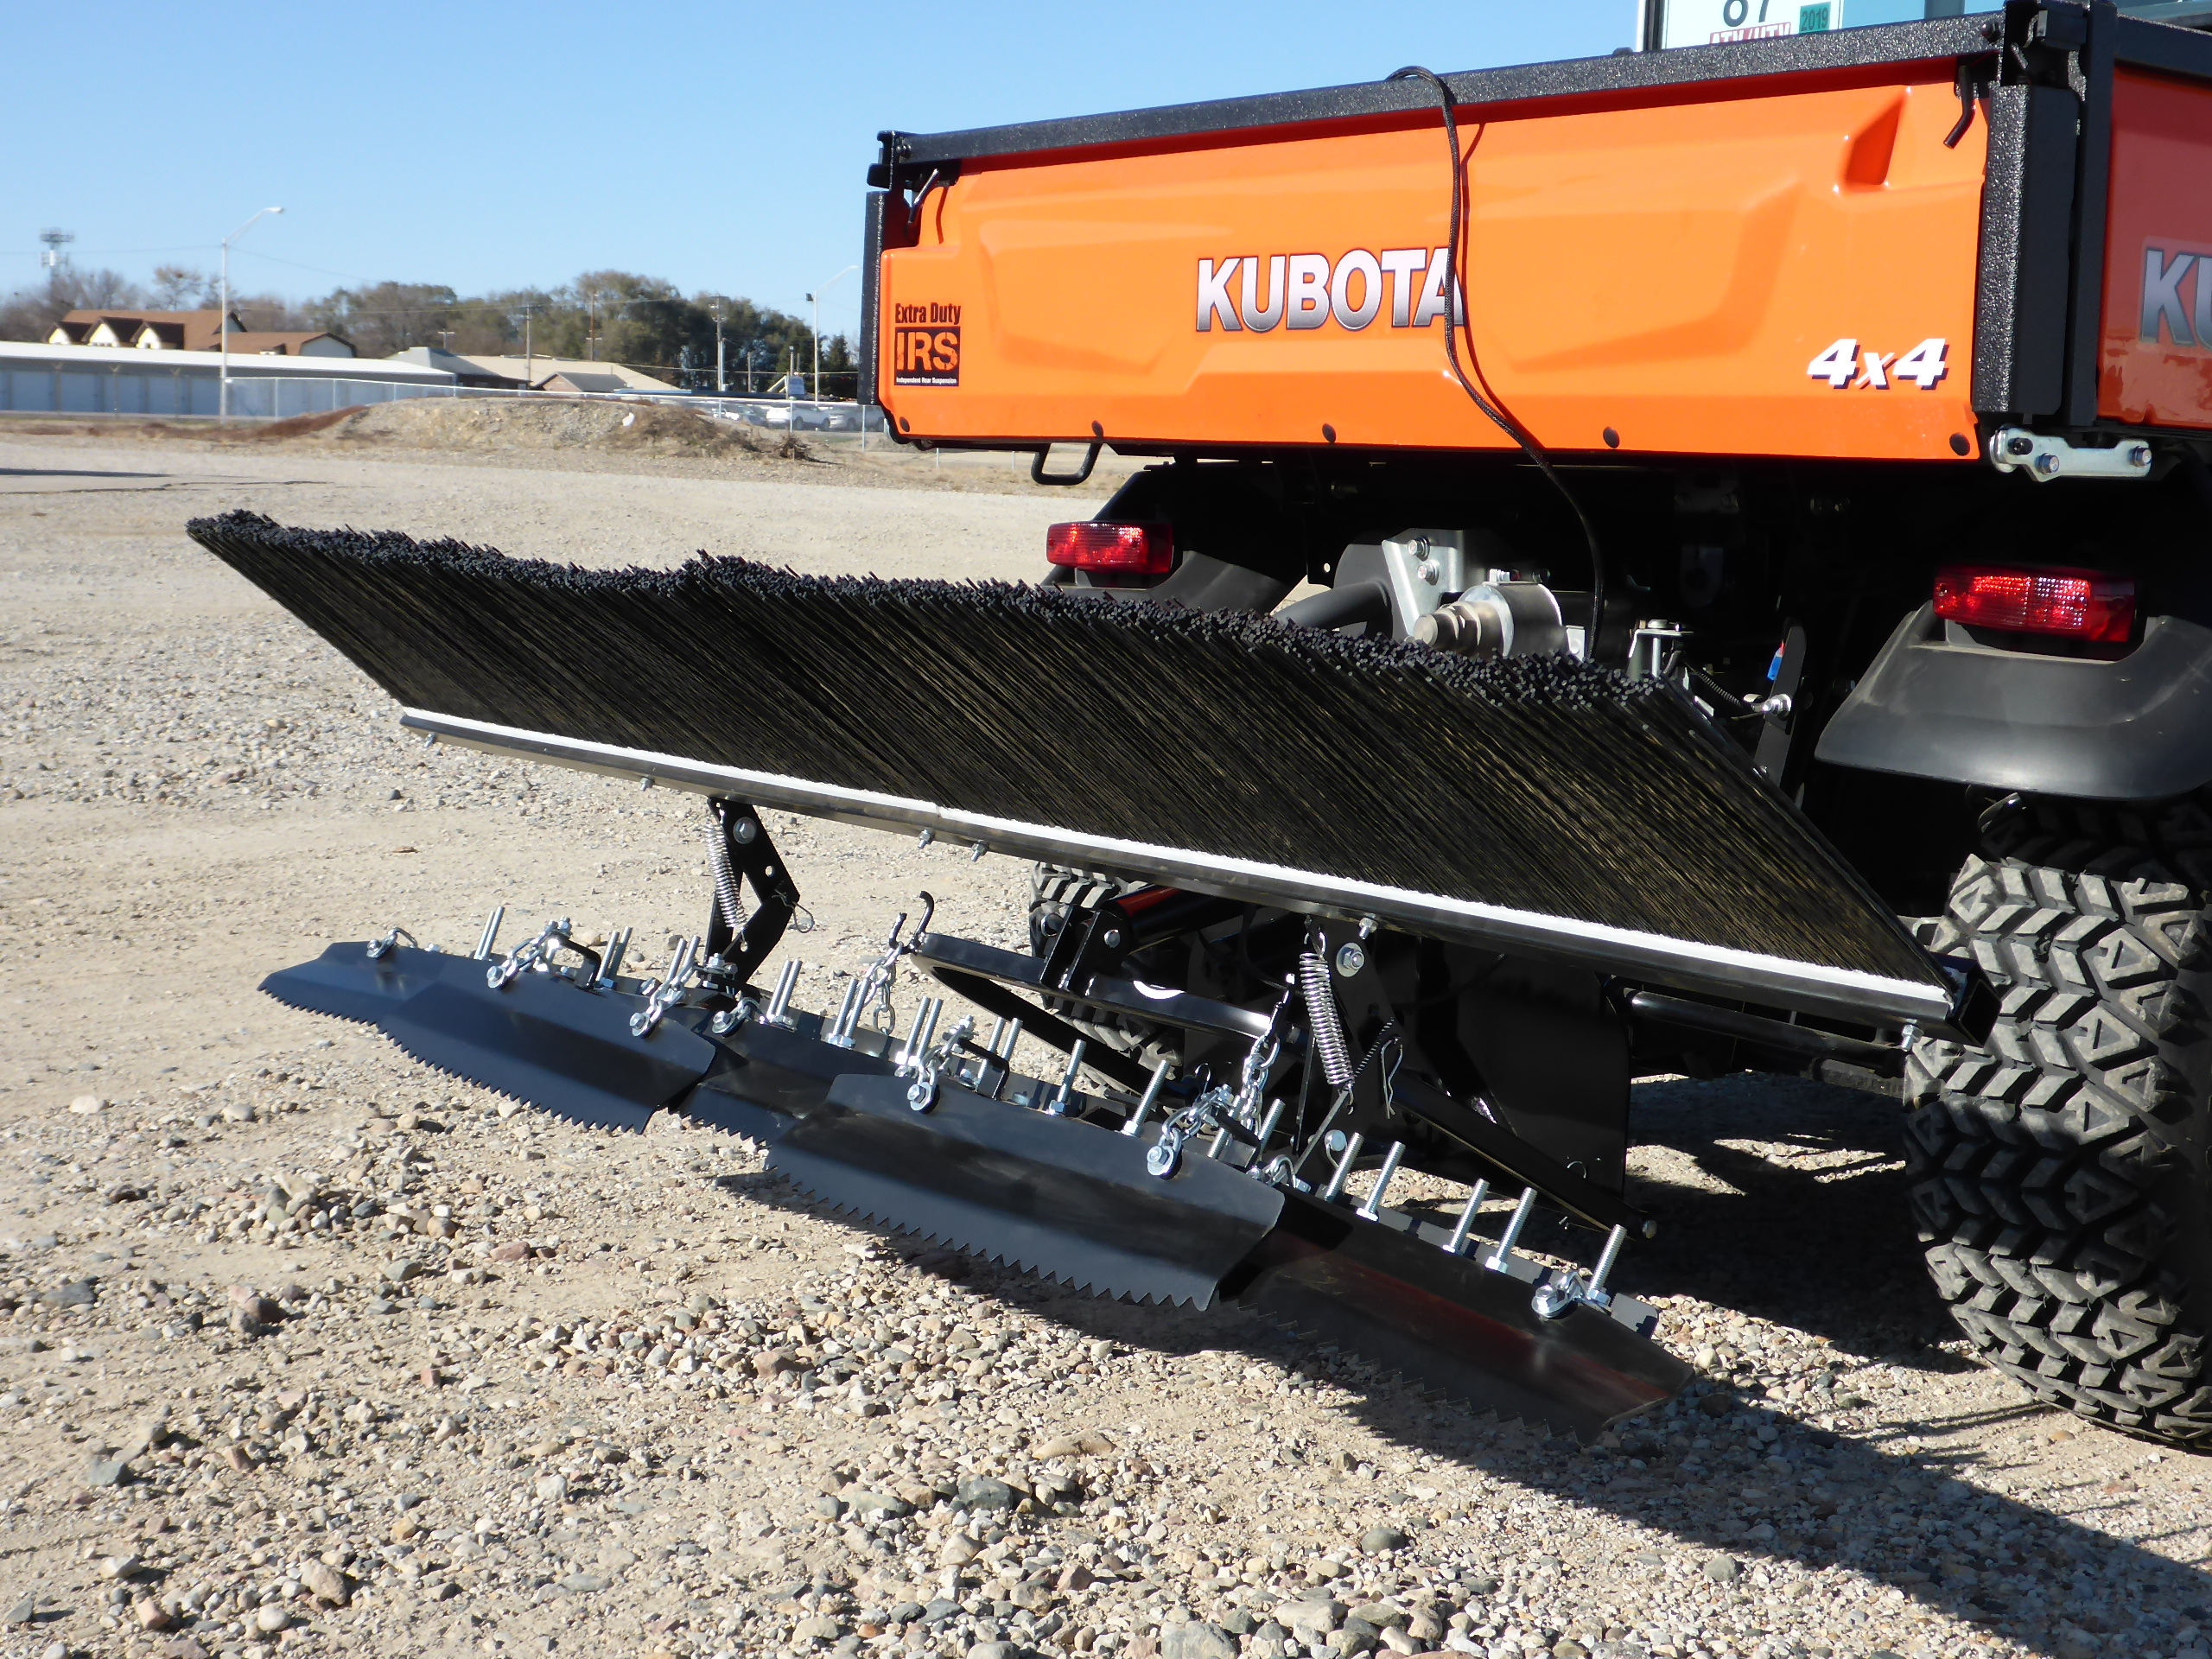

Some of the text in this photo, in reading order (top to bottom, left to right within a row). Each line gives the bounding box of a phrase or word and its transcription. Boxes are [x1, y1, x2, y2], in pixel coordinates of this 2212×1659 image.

[1801, 7, 1829, 32] 2019
[1196, 247, 1466, 333] KUBOTA
[895, 302, 961, 325] Extra Duty
[896, 332, 958, 371] IRS
[1807, 338, 1948, 391] 4x4
